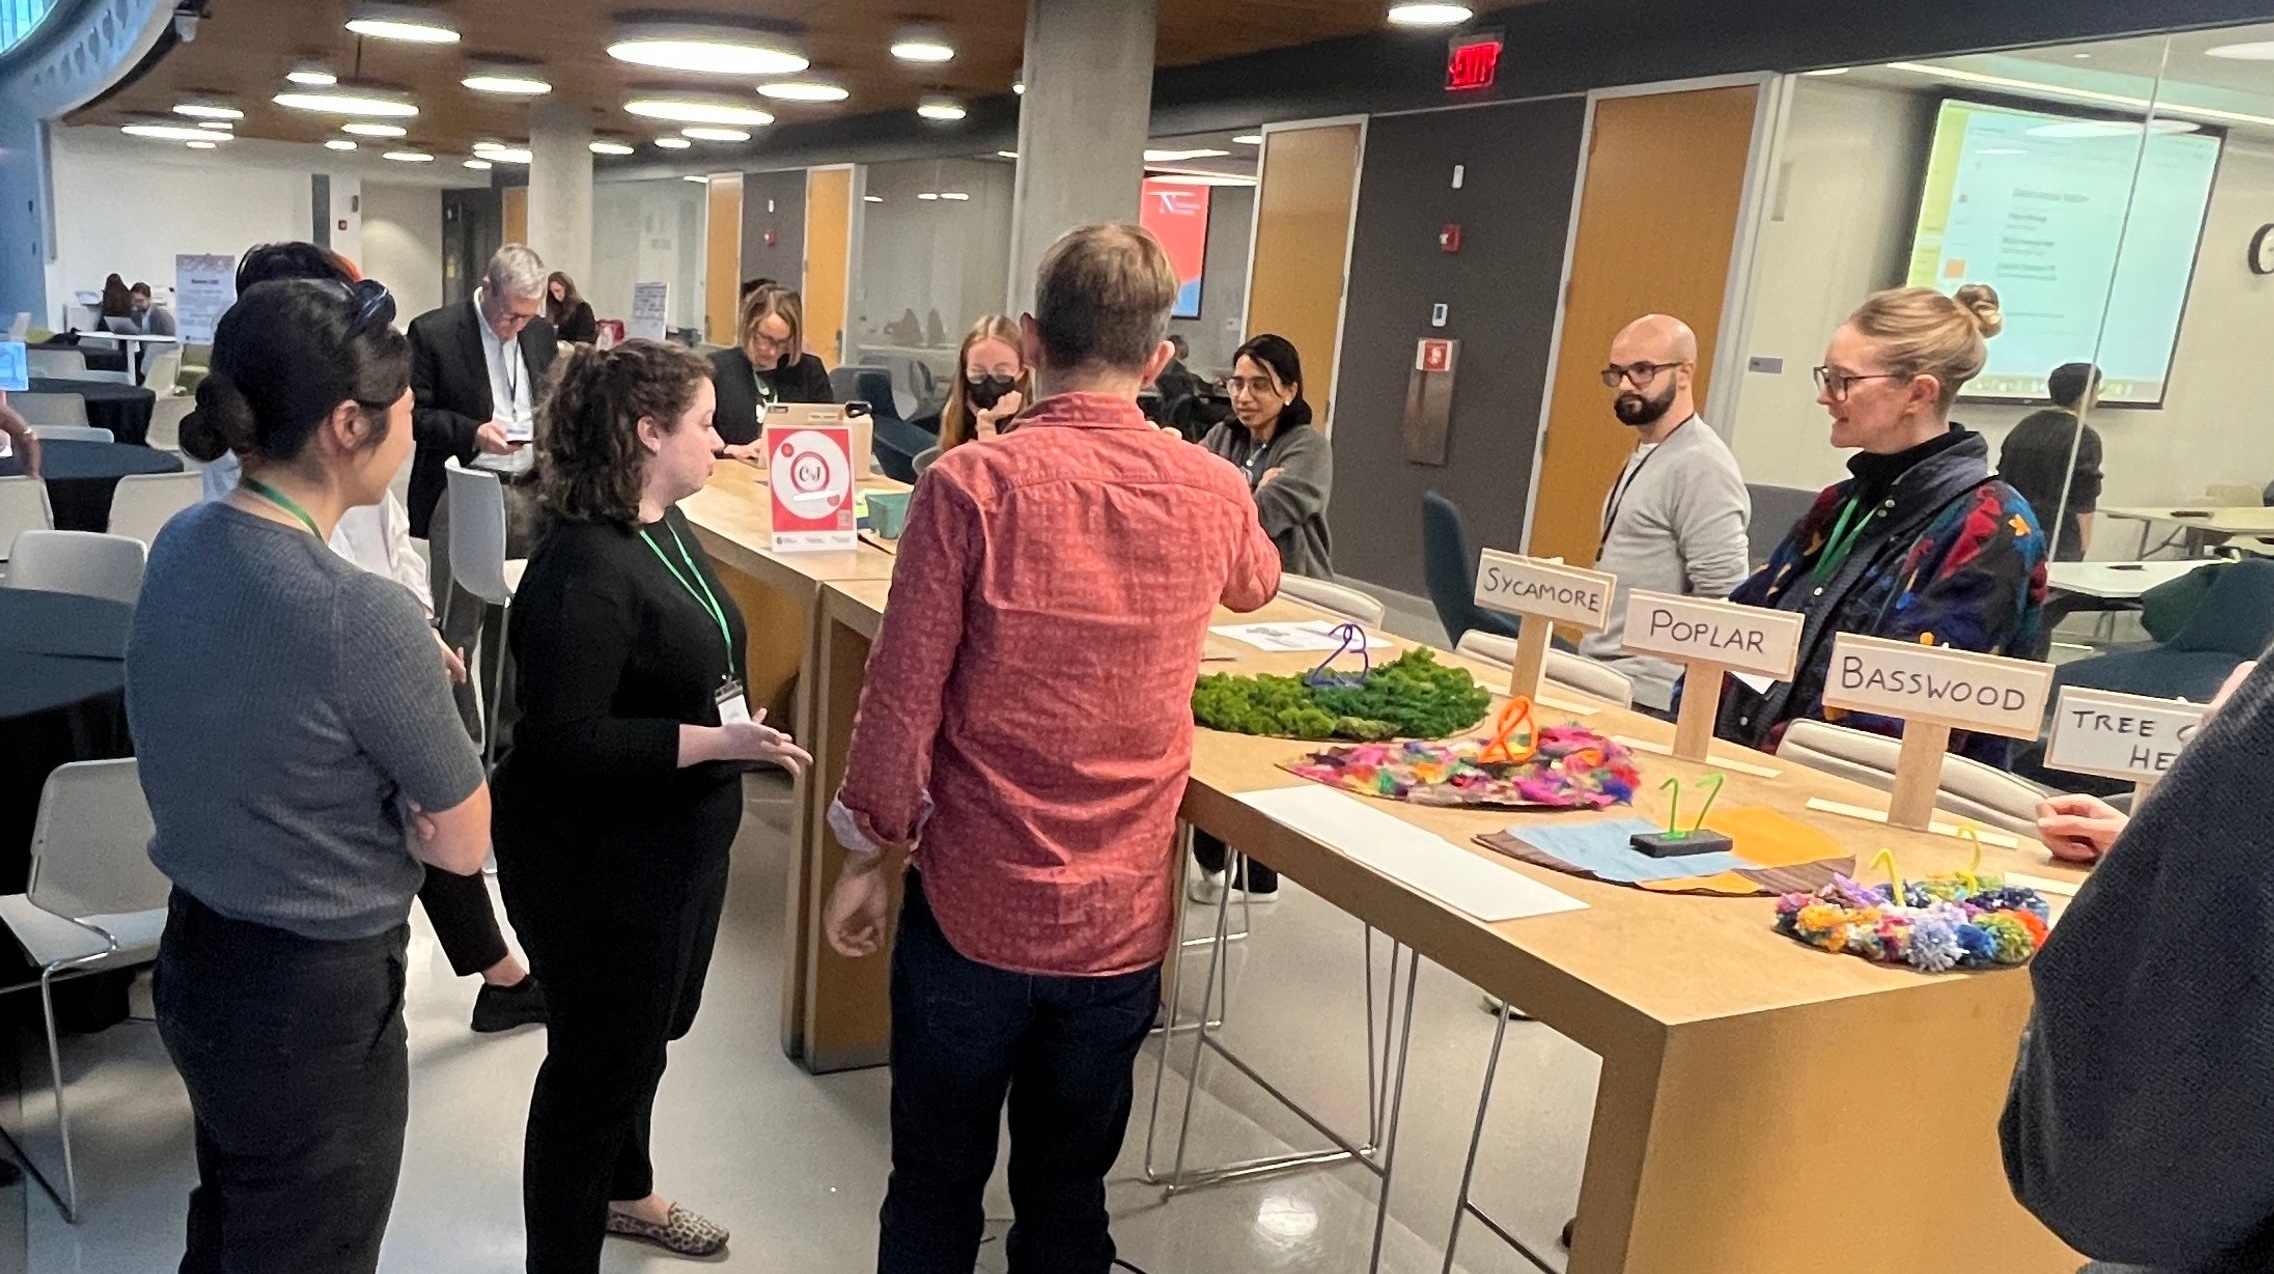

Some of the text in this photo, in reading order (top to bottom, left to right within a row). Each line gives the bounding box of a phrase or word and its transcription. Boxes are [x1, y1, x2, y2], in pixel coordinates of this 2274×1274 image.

[1483, 567, 1600, 613] SYCAMORE
[1649, 609, 1765, 654] POPLAR
[1841, 656, 2025, 711] BASSWOOD
[2072, 711, 2157, 738] TREE
